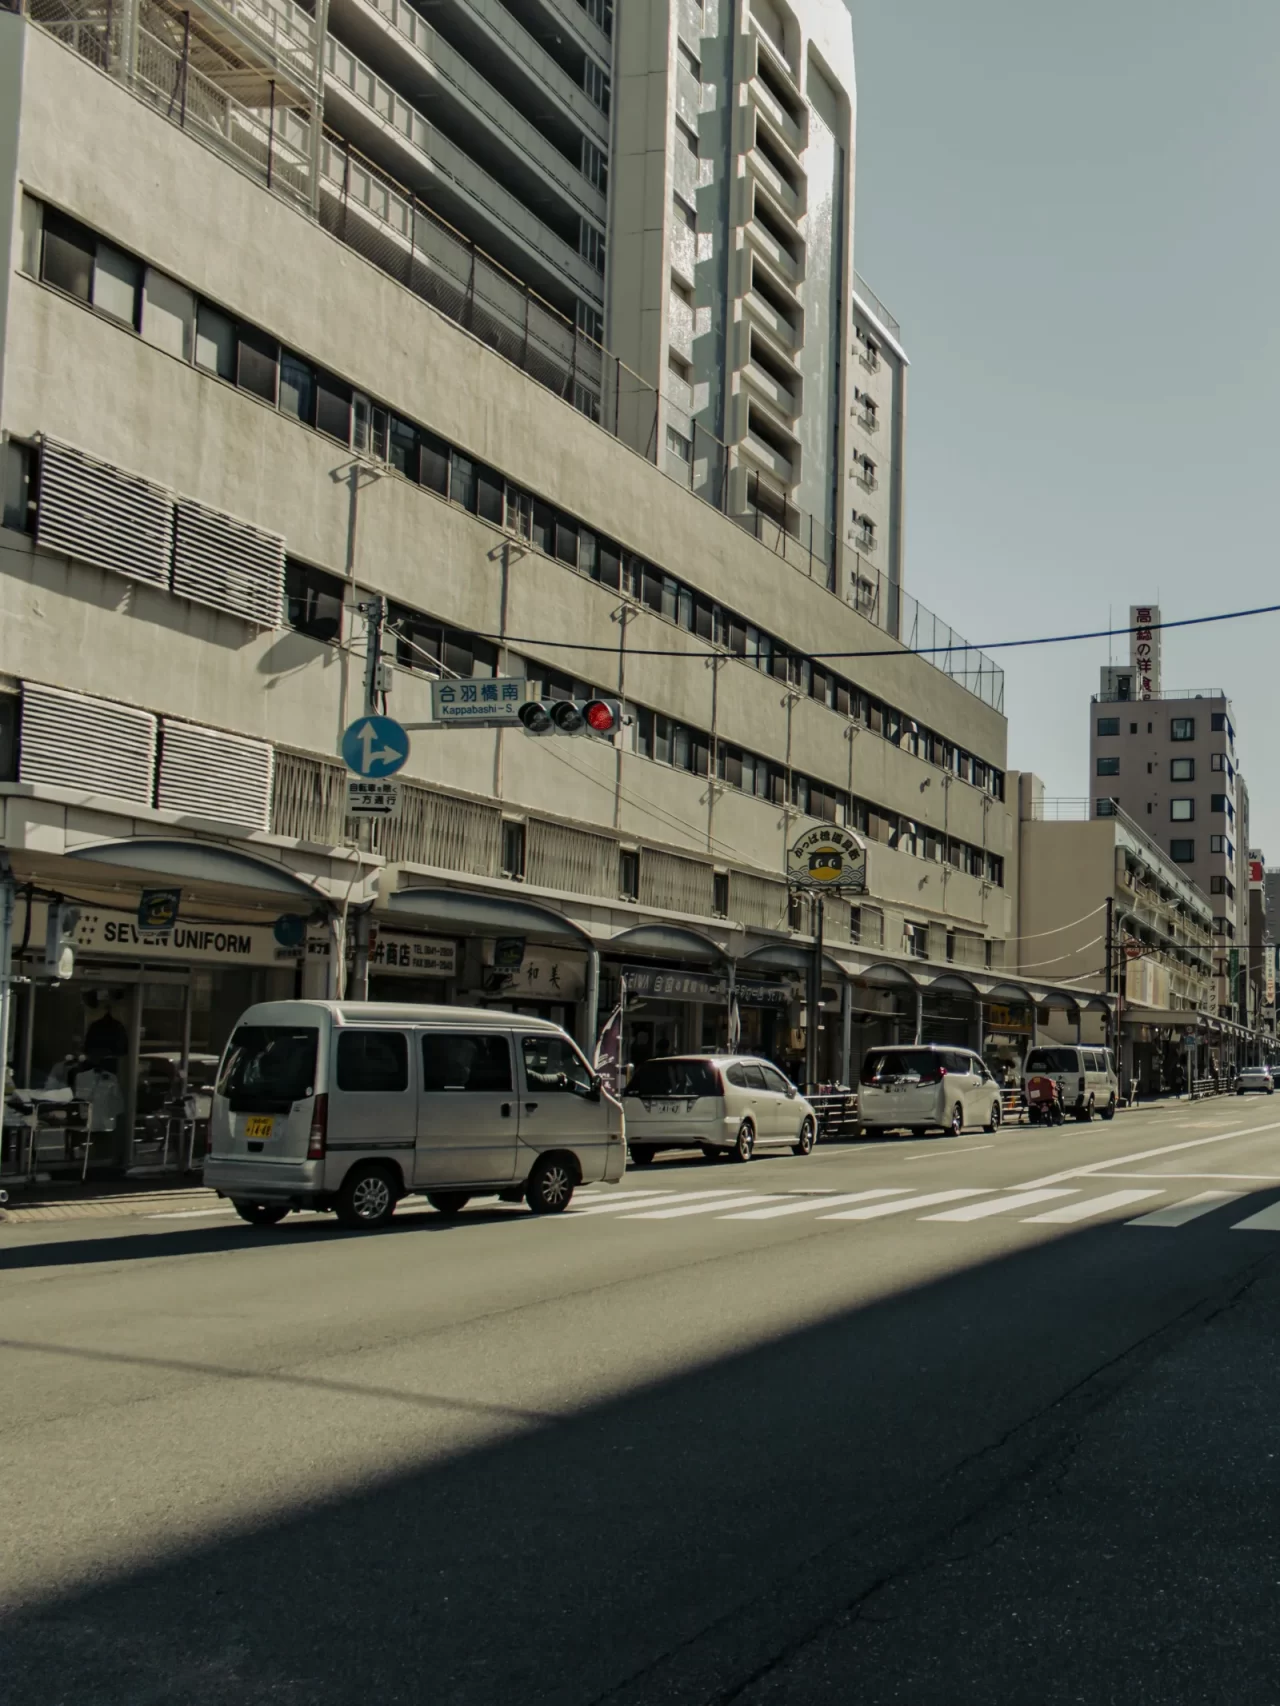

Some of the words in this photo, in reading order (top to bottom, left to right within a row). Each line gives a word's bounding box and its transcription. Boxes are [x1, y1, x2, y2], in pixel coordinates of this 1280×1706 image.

[439, 684, 518, 702] 合羽橋南
[349, 795, 397, 805] 一方通行
[173, 929, 252, 953] UNIFORM
